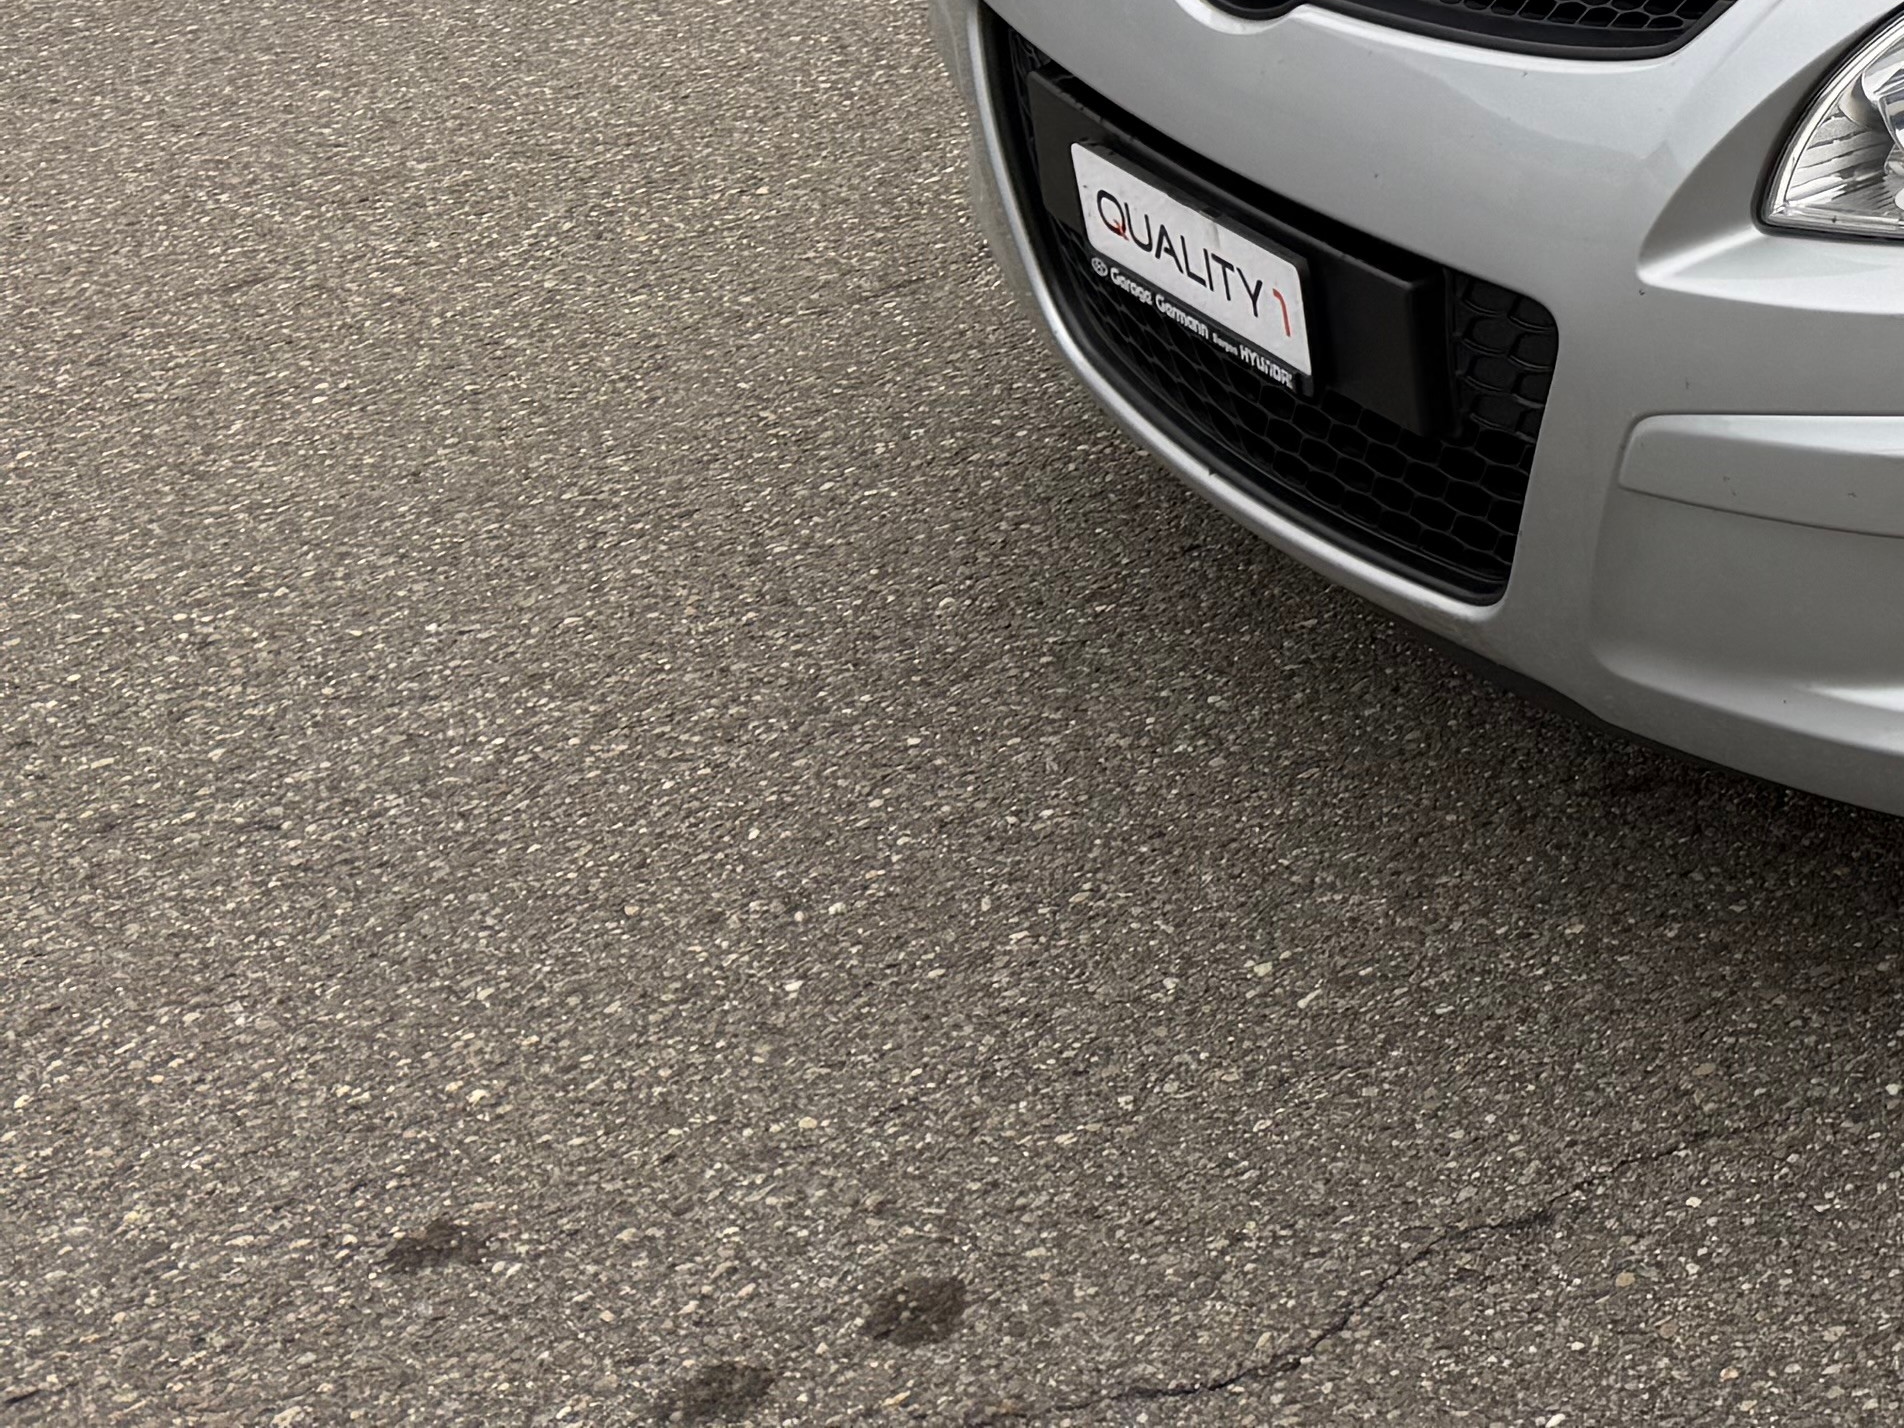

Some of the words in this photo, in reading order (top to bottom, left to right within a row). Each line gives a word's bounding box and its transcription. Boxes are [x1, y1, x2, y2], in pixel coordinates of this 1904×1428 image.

[1097, 189, 1263, 318] QUALITY
[1110, 267, 1153, 305] Garage
[1155, 293, 1209, 340] Germann
